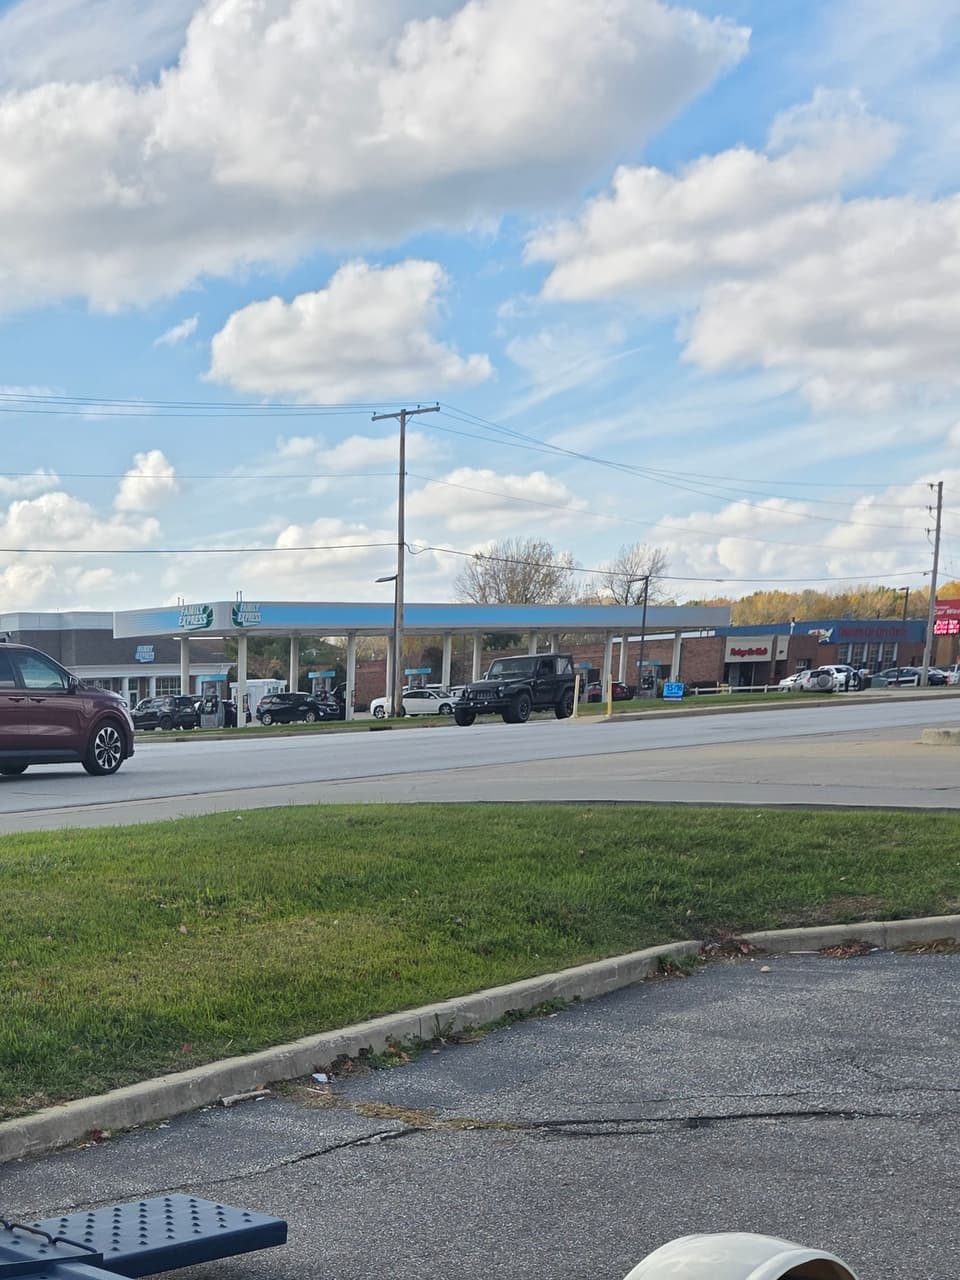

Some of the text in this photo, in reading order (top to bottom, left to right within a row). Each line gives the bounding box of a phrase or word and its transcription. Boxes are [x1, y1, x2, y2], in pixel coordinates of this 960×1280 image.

[181, 606, 203, 615] FAMILY
[178, 614, 208, 626] EXPRESS
[238, 612, 262, 622] EXPRESS
